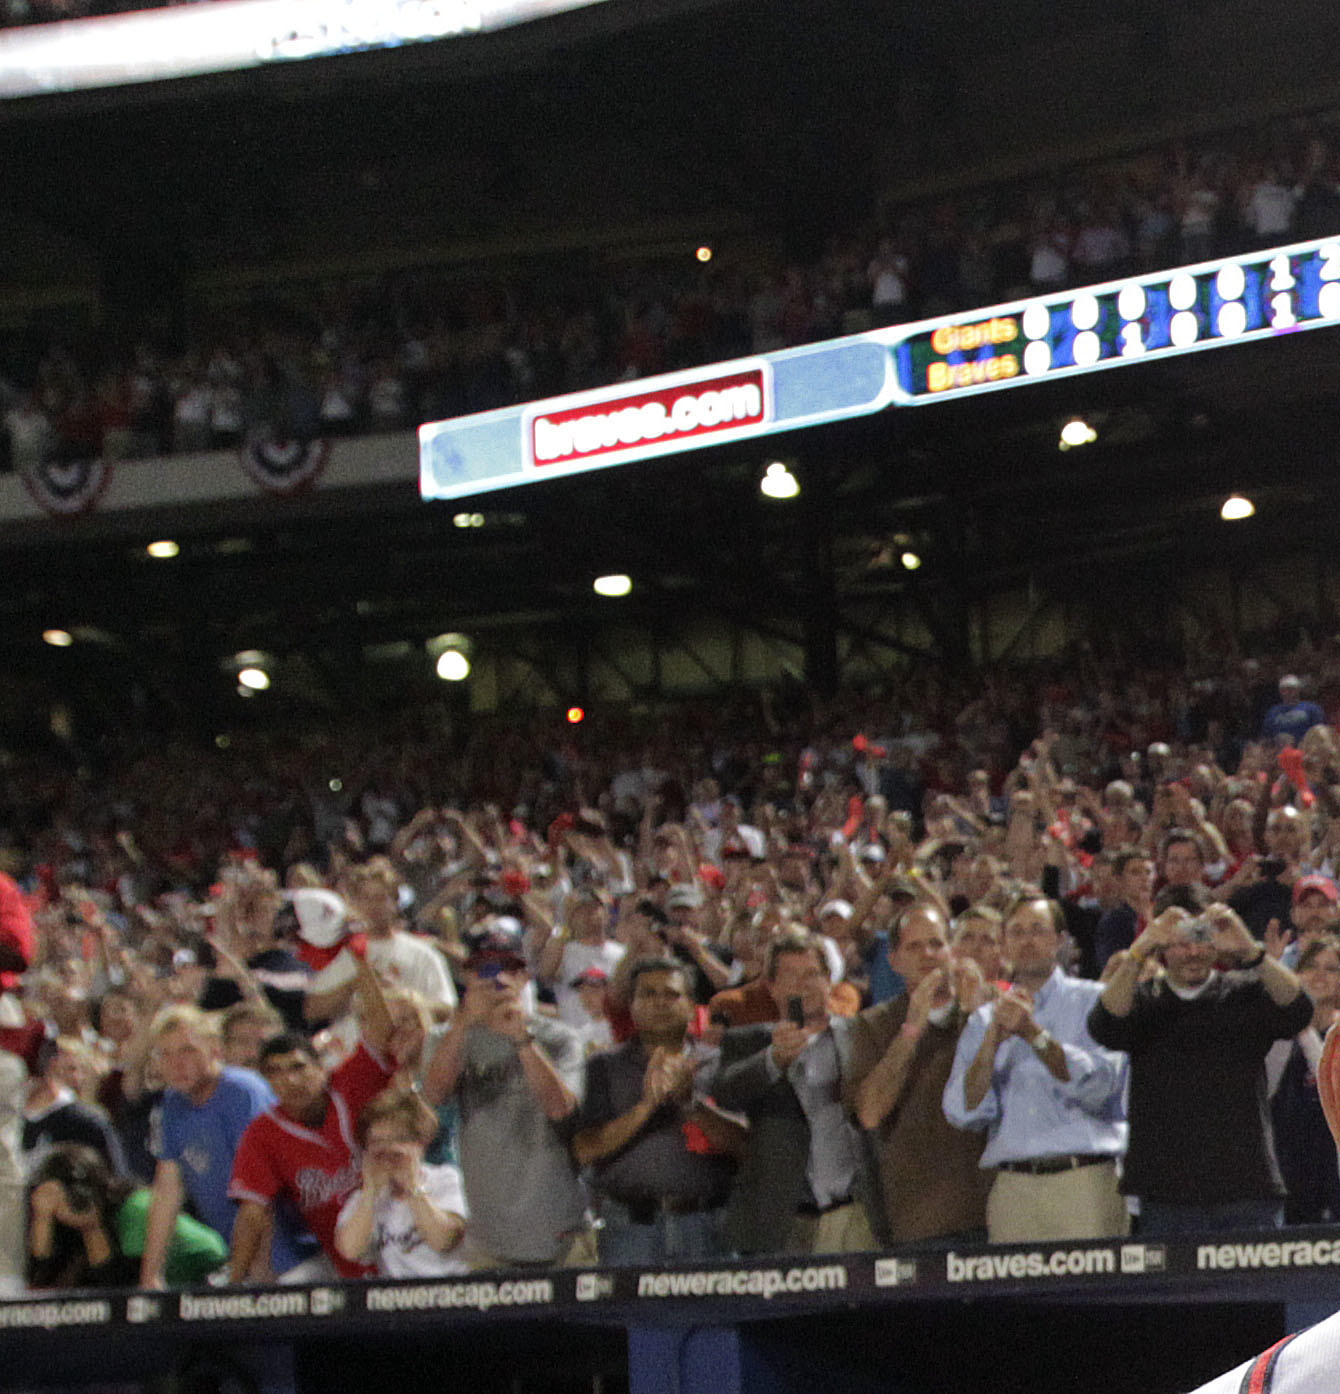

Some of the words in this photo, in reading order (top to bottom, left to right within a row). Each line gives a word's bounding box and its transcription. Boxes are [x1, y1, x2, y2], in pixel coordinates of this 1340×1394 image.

[931, 317, 1018, 355] Giants
[927, 354, 1019, 392] Braves
[534, 383, 761, 460] braves.com
[638, 1264, 847, 1299] neweracap.com
[946, 1244, 1115, 1282] braves.com
[180, 1291, 307, 1319] braves.com
[367, 1279, 553, 1311] neweracap.com
